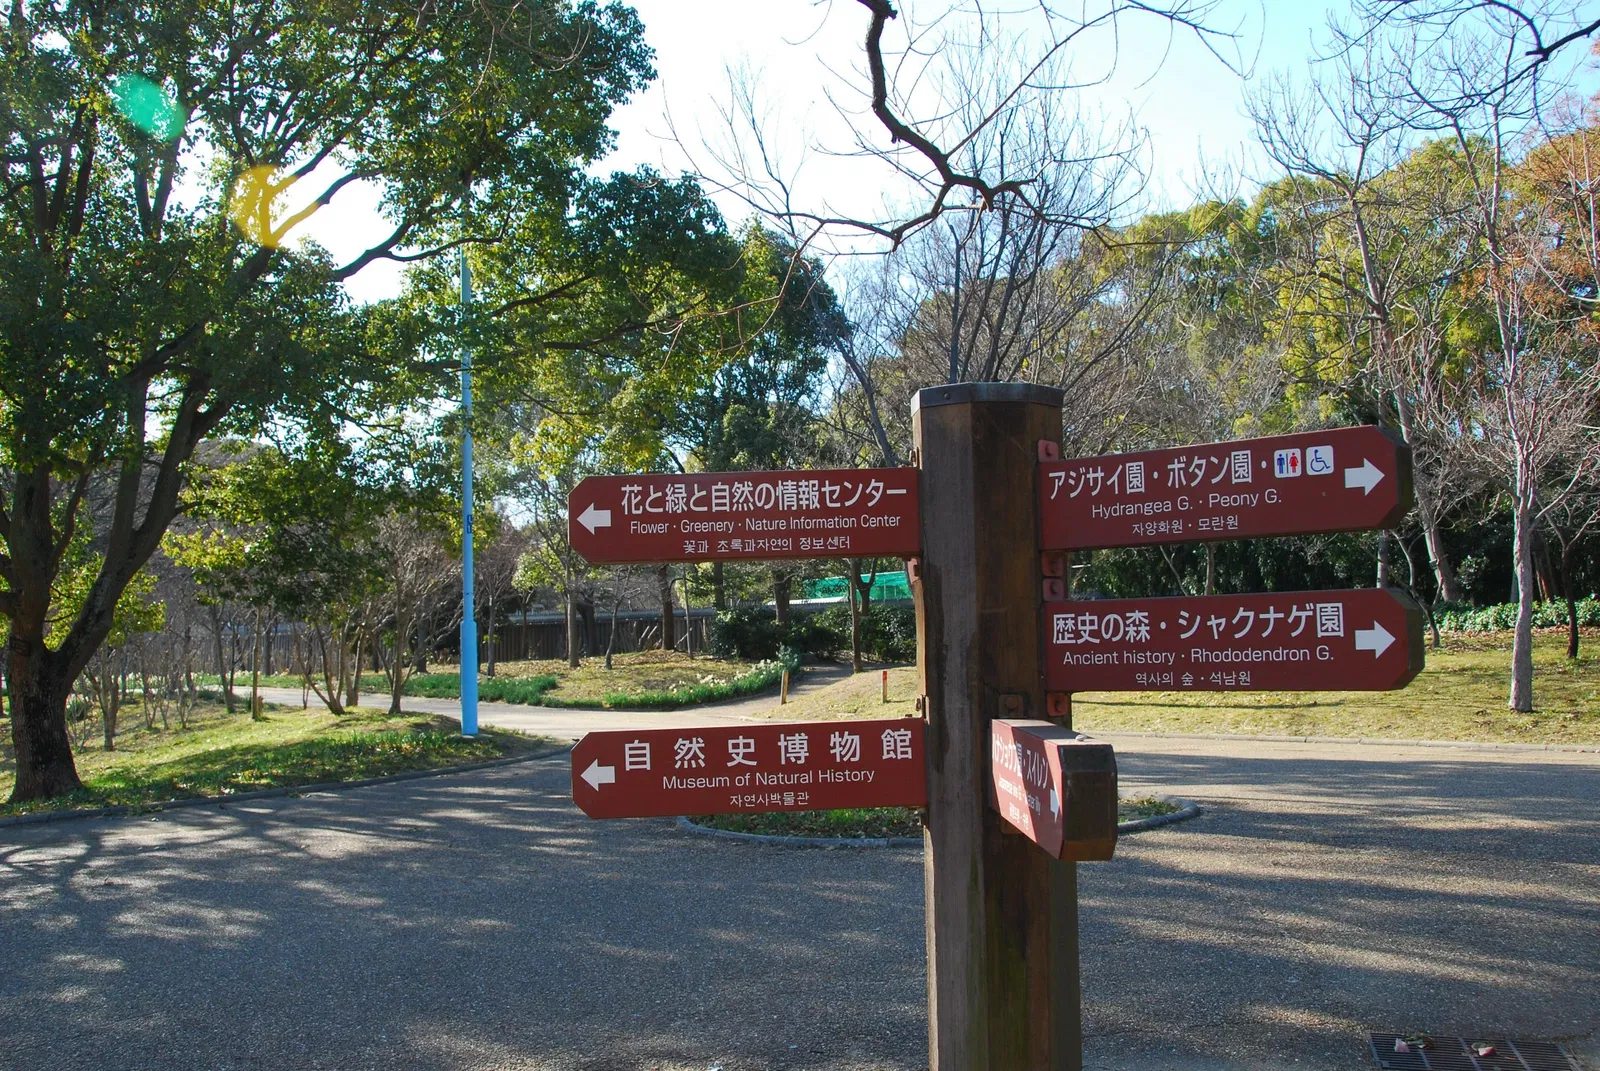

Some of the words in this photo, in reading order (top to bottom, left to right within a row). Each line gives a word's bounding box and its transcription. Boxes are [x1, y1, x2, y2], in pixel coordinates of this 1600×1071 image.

[620, 478, 907, 517] 花と緑と自然の情報センター
[1092, 500, 1172, 520] Hydrangea
[1177, 495, 1193, 511] G.
[1208, 493, 1260, 508] Peony
[1264, 488, 1282, 504] G.
[630, 520, 670, 534] Flower
[680, 519, 735, 534] Greenery
[745, 517, 787, 531] Nature
[790, 515, 857, 530] Information
[860, 514, 901, 528] Center
[1132, 519, 1183, 536] 자양화원
[1198, 514, 1238, 531] 모란원
[683, 539, 709, 554] 꽃과
[717, 537, 792, 553] 초록과자연의
[799, 535, 850, 551] 정보센터
[1052, 602, 1345, 645] 歴史の森・シャクナゲ園
[1063, 650, 1119, 665] Ancient
[1123, 649, 1176, 666] history
[1191, 646, 1310, 663] Rhododendron
[1316, 645, 1334, 661] G.
[1135, 671, 1174, 686] 역사의
[1181, 672, 1194, 686] 숲
[1209, 670, 1251, 686] 석남원
[623, 728, 913, 772] 自然史博物館
[662, 775, 730, 790] Museum
[735, 772, 751, 787] of
[755, 770, 813, 786] Natural
[818, 769, 875, 783] History
[730, 791, 810, 807] 자연사박물관
